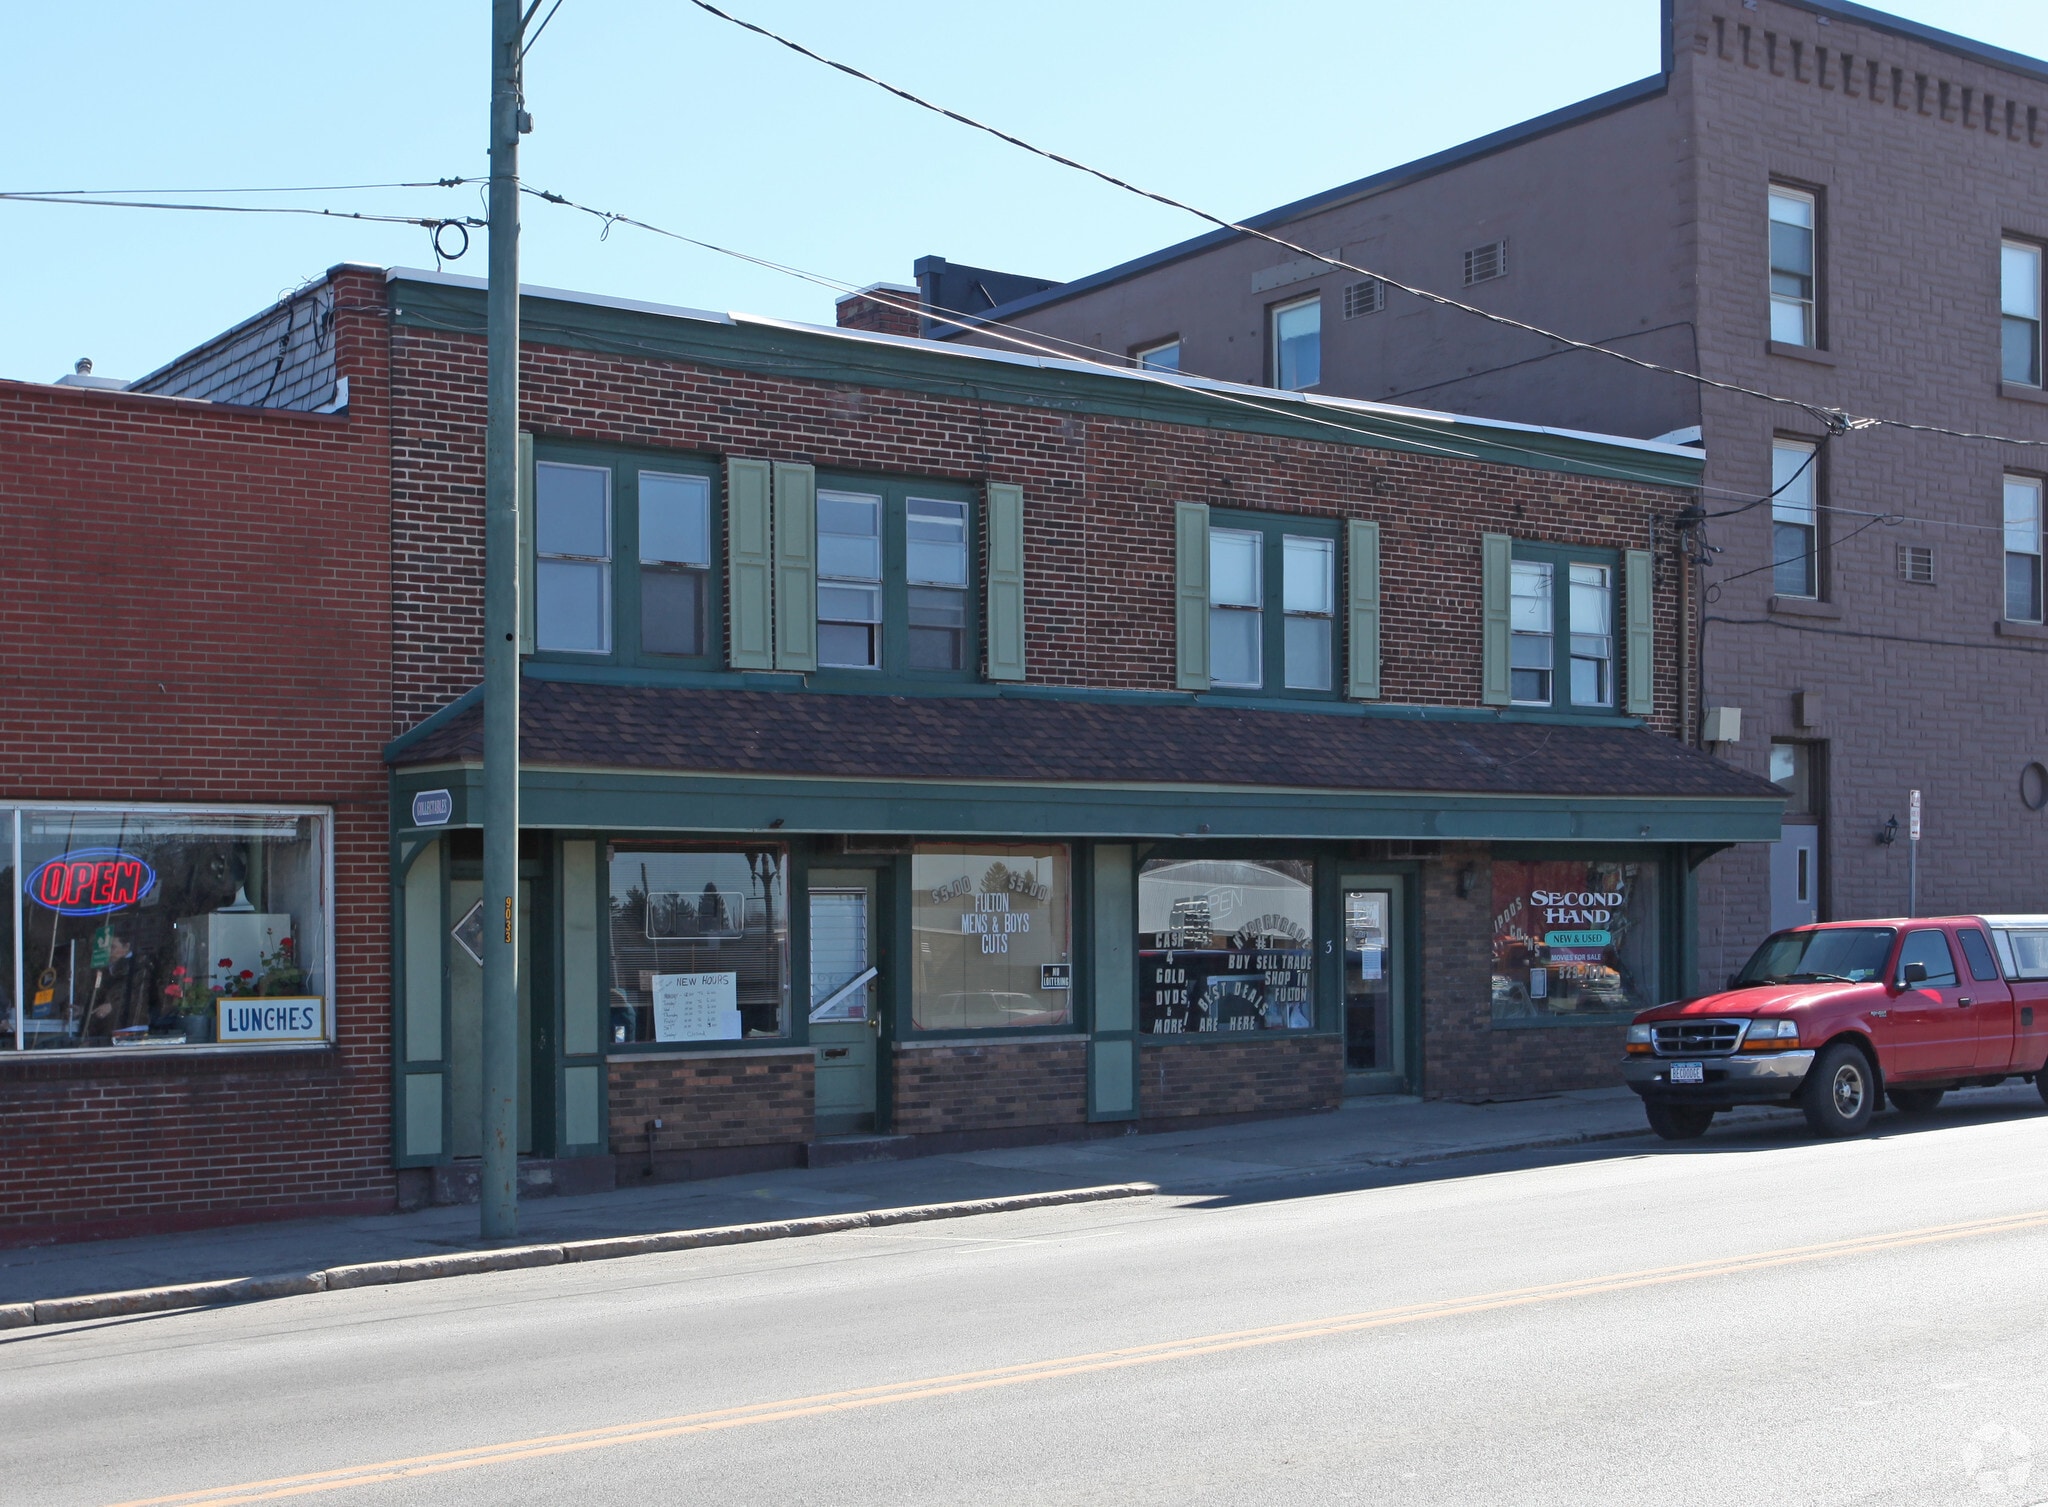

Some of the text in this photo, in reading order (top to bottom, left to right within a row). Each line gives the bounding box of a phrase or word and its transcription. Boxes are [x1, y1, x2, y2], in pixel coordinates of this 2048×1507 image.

[40, 862, 141, 905] OPEN
[931, 875, 972, 905] $5.00
[1008, 876, 1048, 902] $5.00
[975, 892, 1009, 913] FULTON
[1530, 889, 1623, 907] SECOND
[504, 896, 512, 943] 9033
[961, 913, 1030, 934] MENS & BOYS
[1543, 908, 1611, 924] HAND
[1155, 932, 1184, 948] CASH
[1232, 914, 1312, 950] HYPERTRADE
[1553, 934, 1603, 943] NEW & USED
[981, 933, 1008, 954] CUTS
[1166, 950, 1174, 965] 4
[1228, 954, 1312, 970] BUY SELL TRADE
[1586, 953, 1601, 961] SALE
[676, 974, 729, 987] NEW HOURS
[1264, 970, 1291, 986] SHOP
[1198, 981, 1269, 1016] BEST DEALS
[1275, 987, 1307, 1002] FULTON
[228, 1006, 314, 1032] LUNCHES
[1199, 1016, 1256, 1032] ARE HERE
